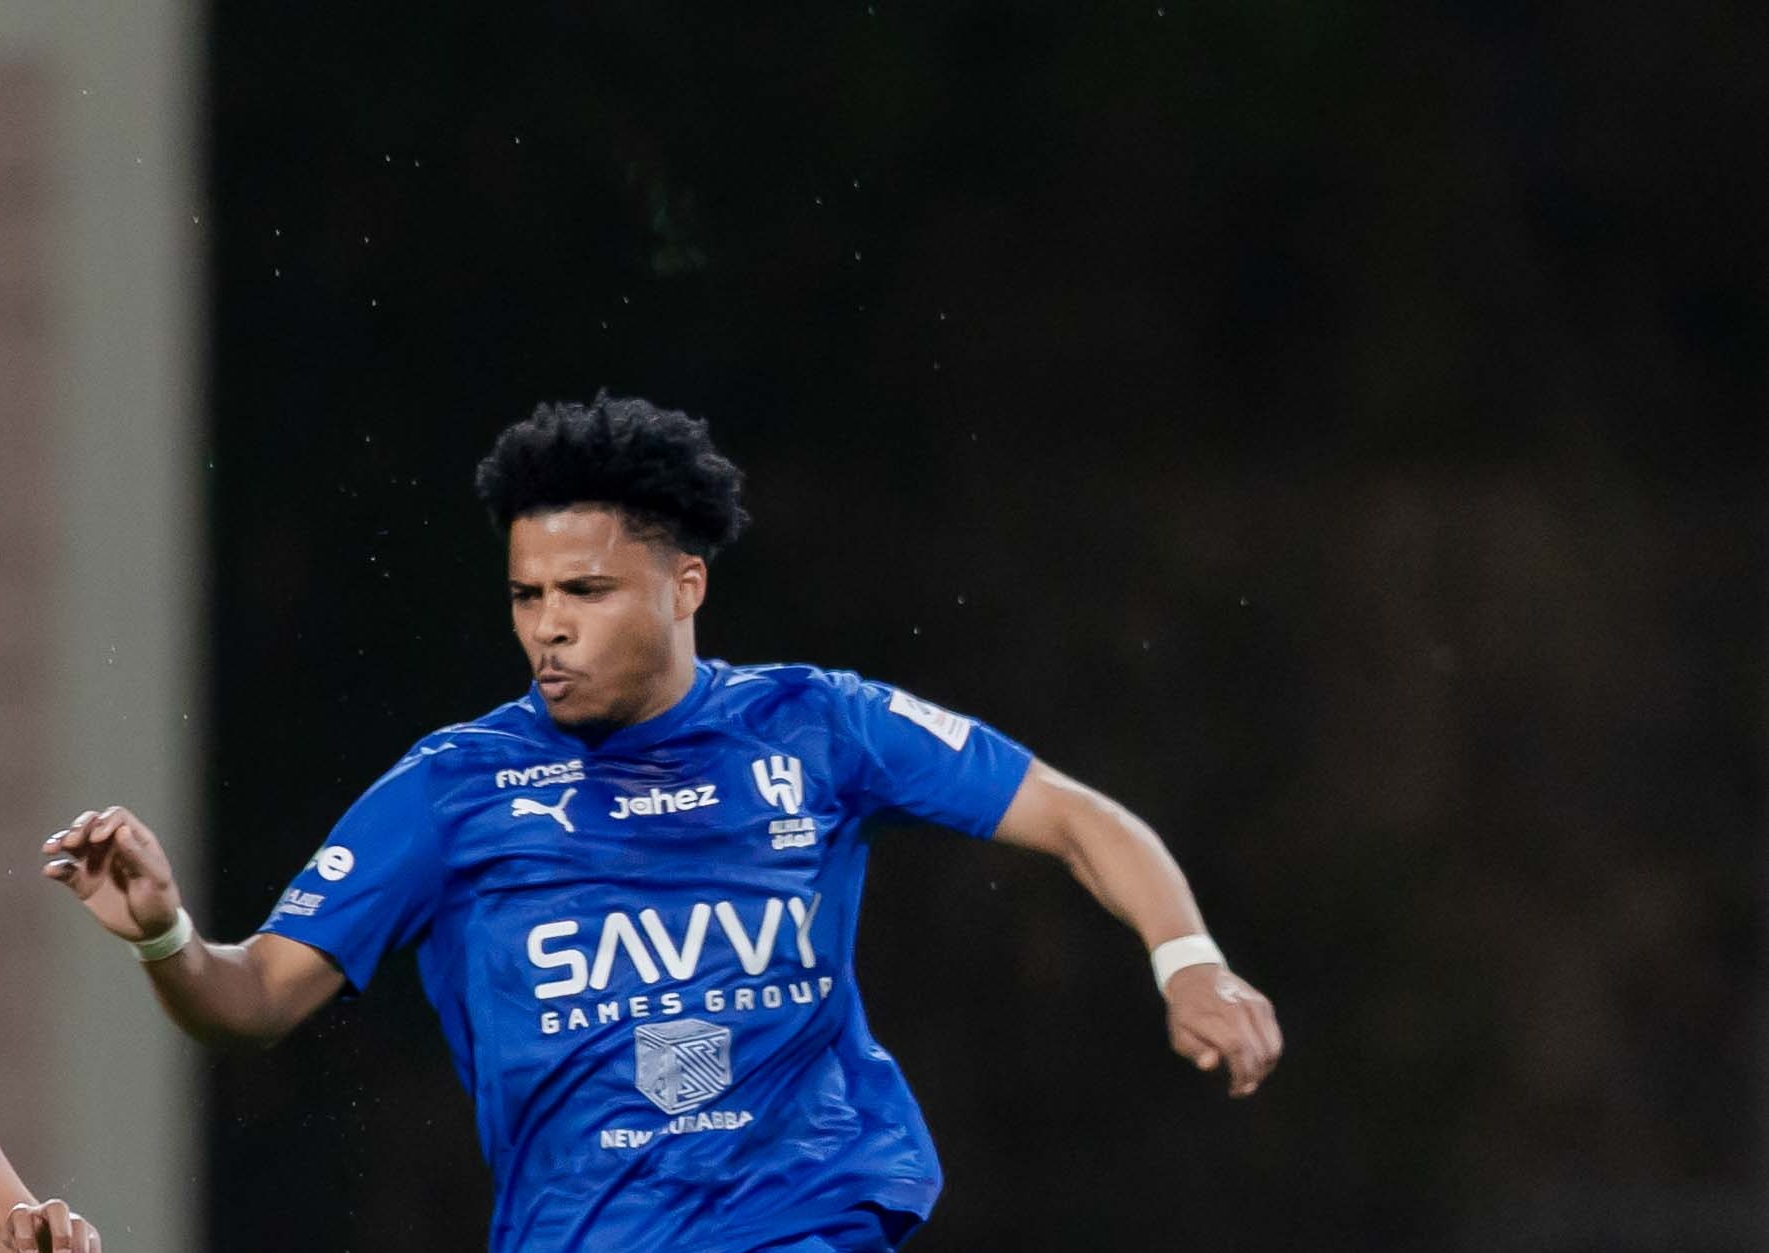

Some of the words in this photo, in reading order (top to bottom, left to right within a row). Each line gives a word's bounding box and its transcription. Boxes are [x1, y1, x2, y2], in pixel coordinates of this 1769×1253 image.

[609, 784, 720, 820] Jahez
[527, 892, 822, 1000] SAVVY
[540, 993, 684, 1035] GAMES
[704, 976, 833, 1013] GROUP
[600, 1129, 653, 1149] NEW
